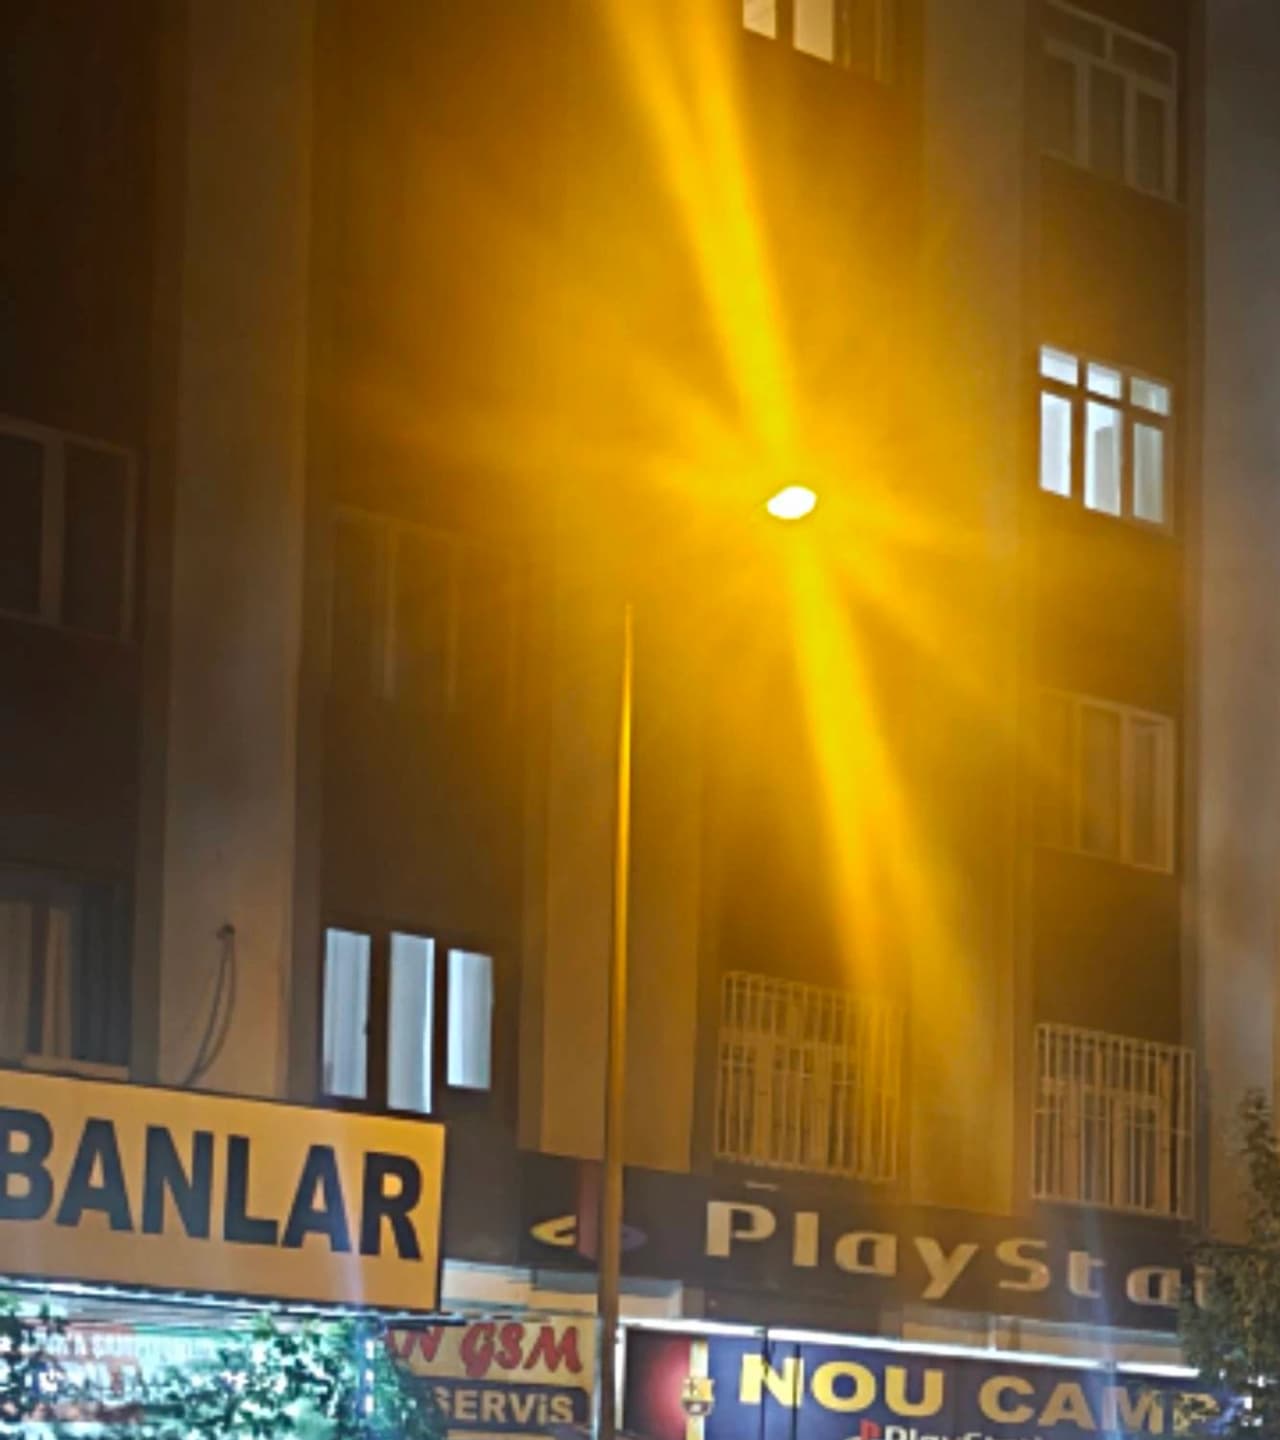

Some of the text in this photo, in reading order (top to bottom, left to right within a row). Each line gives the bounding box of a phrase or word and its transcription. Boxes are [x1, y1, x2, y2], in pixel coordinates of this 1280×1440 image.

[0, 1109, 423, 1260] BANLAR
[459, 1321, 583, 1378] GSM
[739, 1353, 1221, 1436] NOU CAMP
